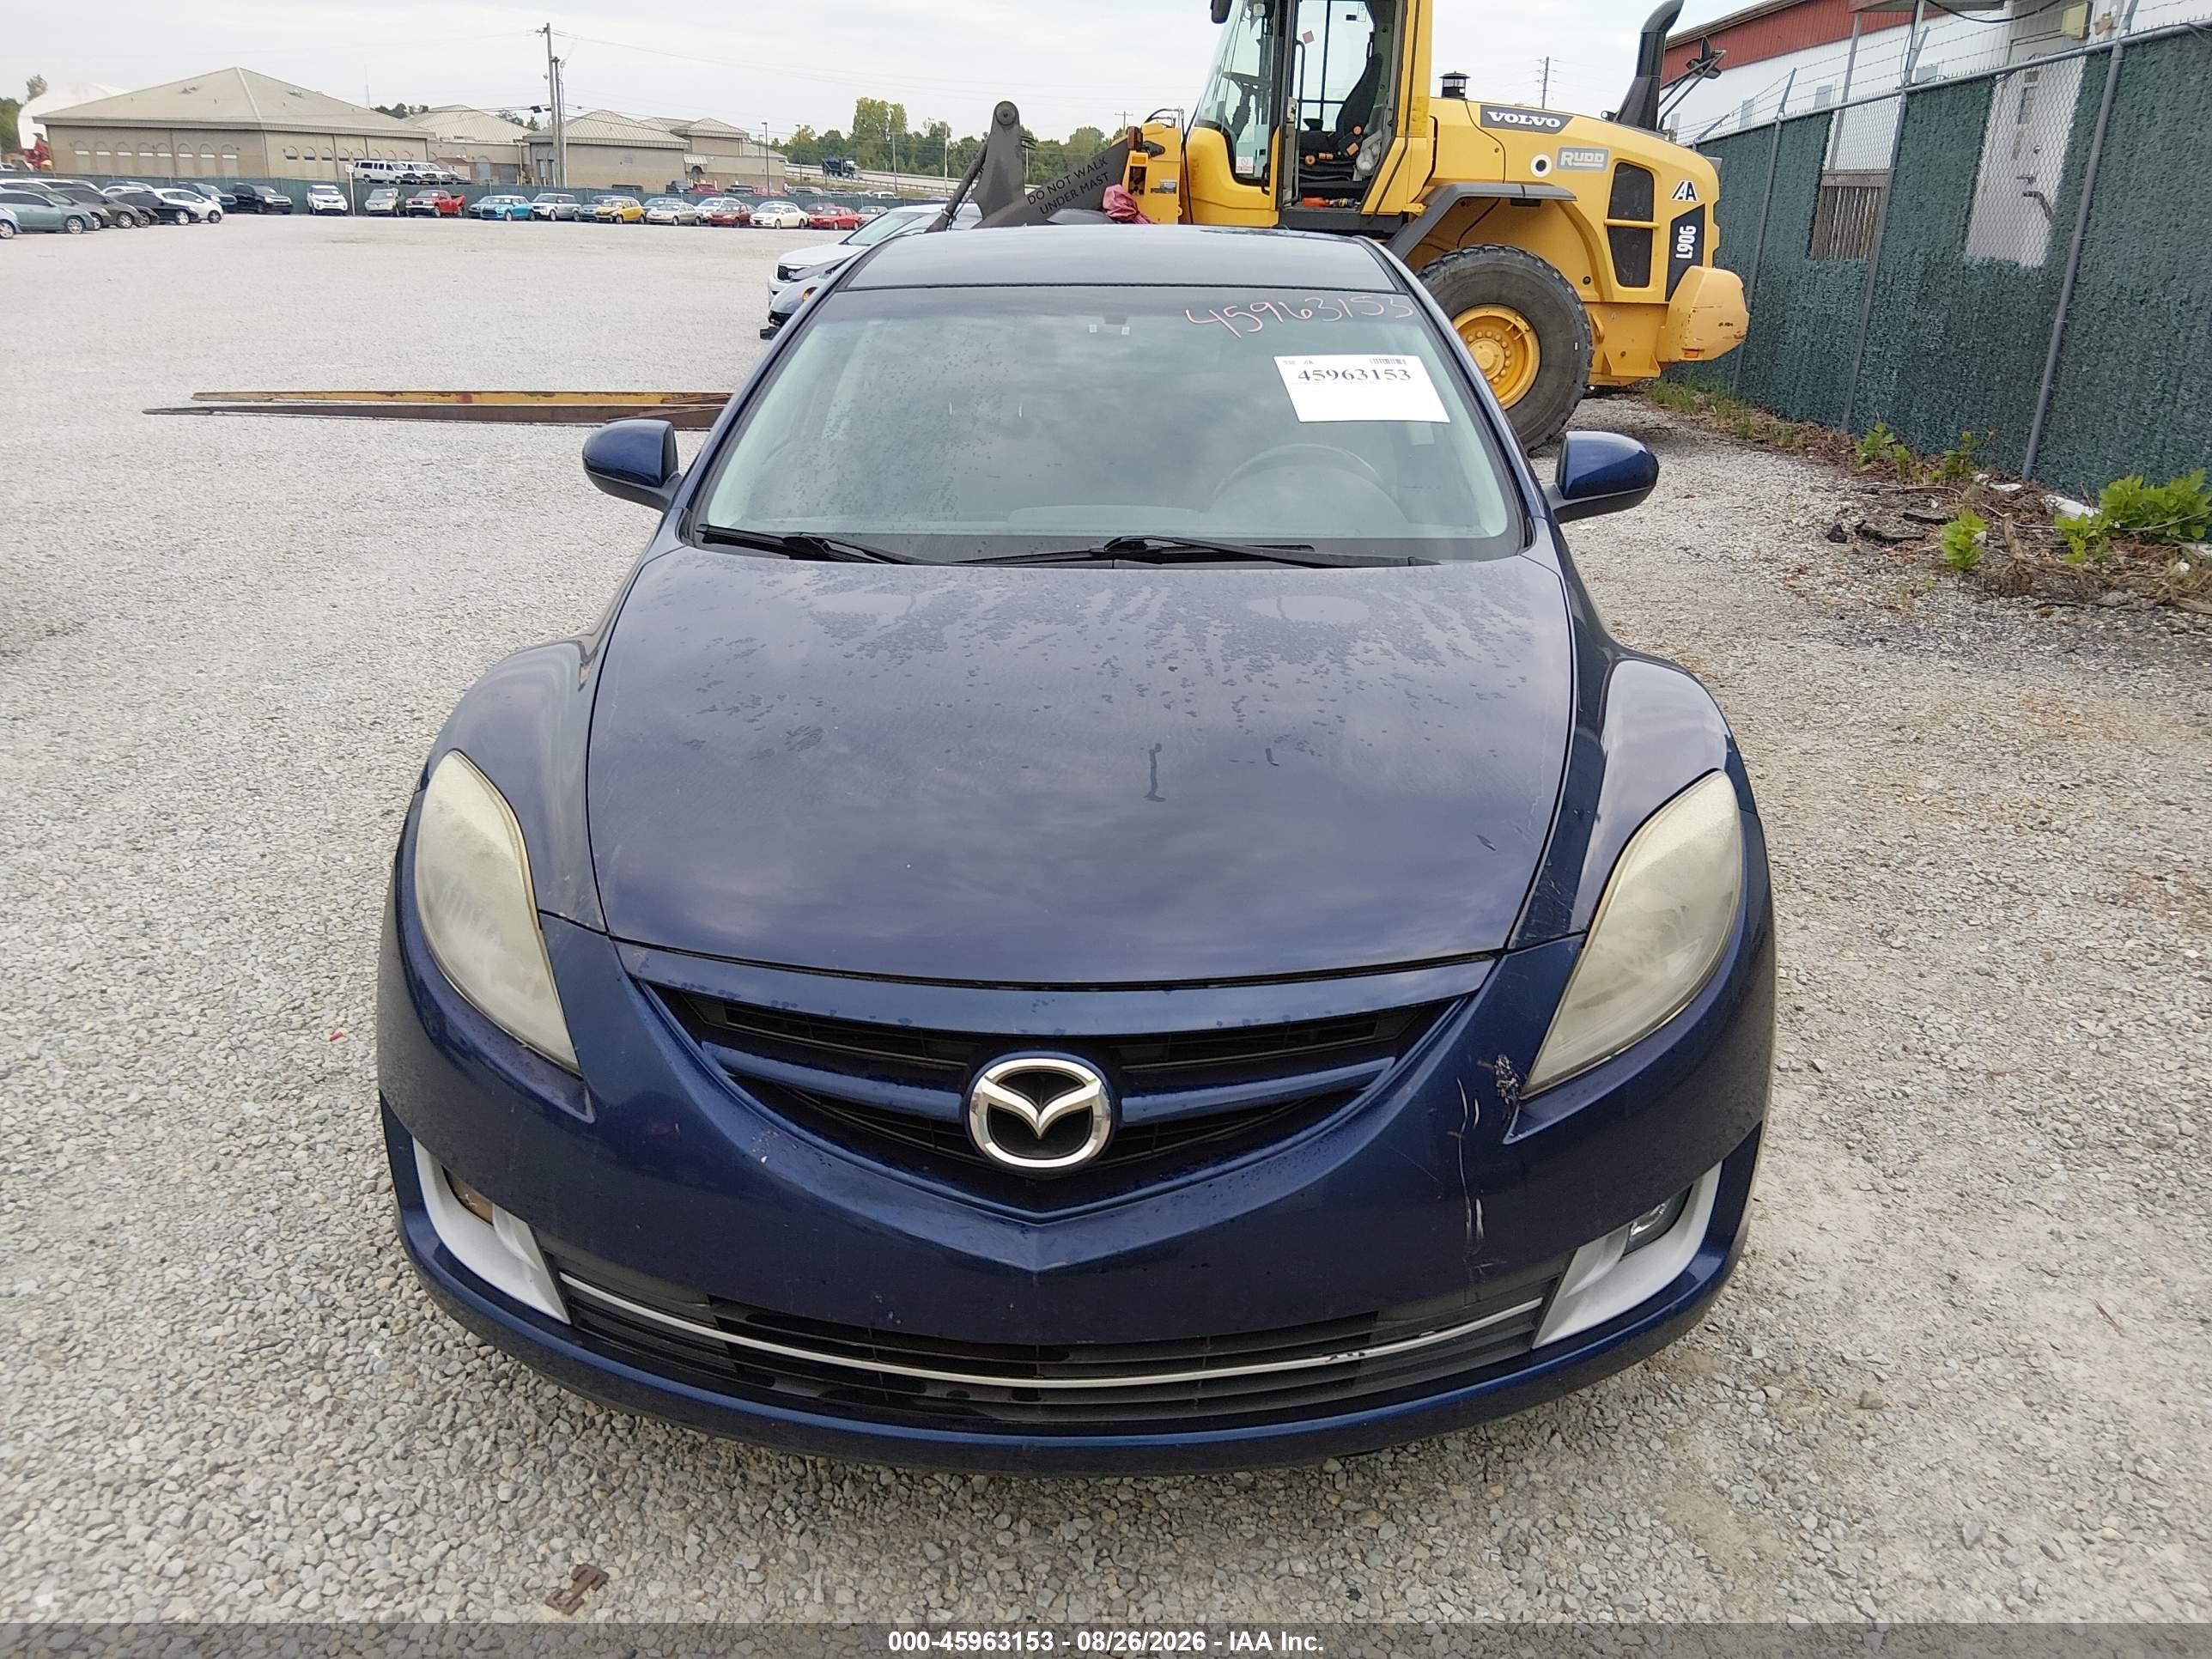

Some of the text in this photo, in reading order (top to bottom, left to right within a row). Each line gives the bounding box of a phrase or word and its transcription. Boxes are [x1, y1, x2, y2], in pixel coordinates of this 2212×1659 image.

[1486, 111, 1561, 128] VOLVO
[1560, 150, 1606, 166] RUDD
[1026, 156, 1109, 205] DO NOT WALK
[1039, 172, 1110, 215] UNDER MAST
[1675, 225, 1697, 259] L90G
[1185, 295, 1414, 338] 45963153
[1297, 368, 1412, 381] 45963153
